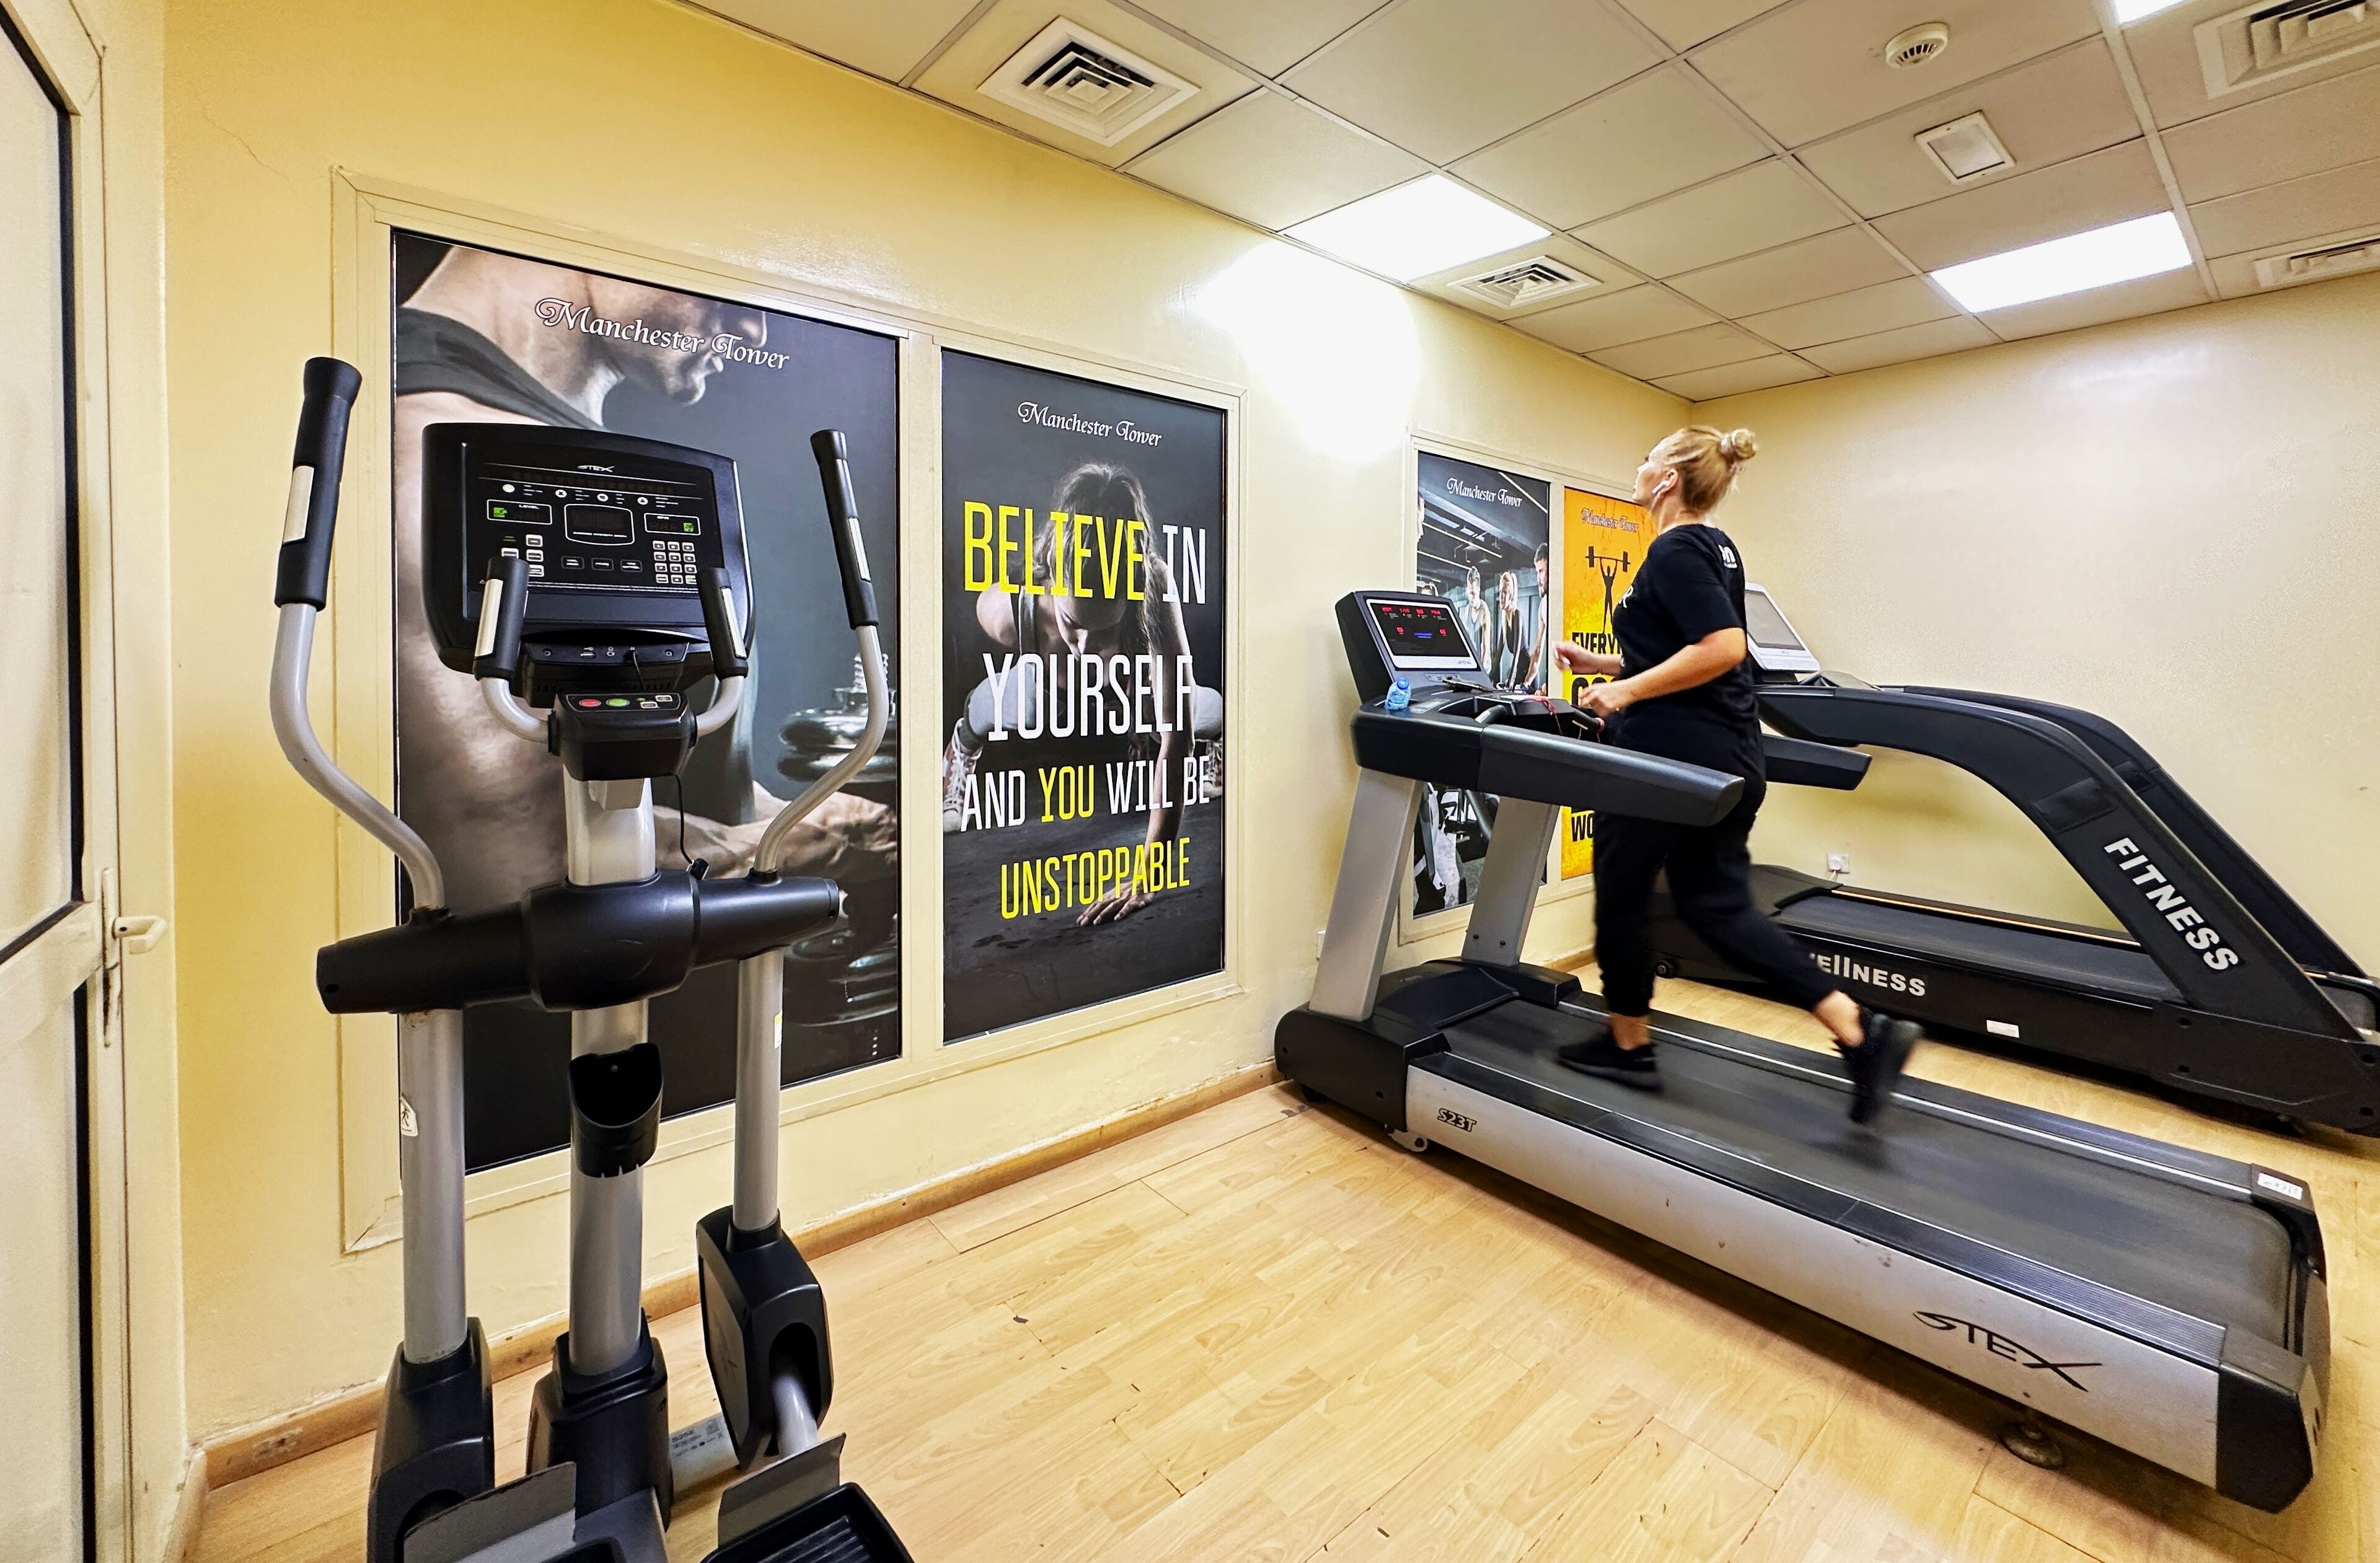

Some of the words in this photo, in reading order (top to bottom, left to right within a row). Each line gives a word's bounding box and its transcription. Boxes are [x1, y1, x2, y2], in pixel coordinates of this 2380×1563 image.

[535, 297, 705, 353] Manchester
[711, 333, 790, 369] Tower
[1018, 401, 1113, 437] Manchester
[1116, 420, 1162, 446] Tower
[1447, 477, 1497, 502] Manchester
[1497, 488, 1523, 507] Tower
[1580, 508, 1618, 529] Manchester
[1620, 516, 1639, 533] Tower
[964, 501, 1145, 601] BELIEVE
[1162, 524, 1206, 604] IN
[1572, 632, 1621, 654] EVERY
[982, 652, 1193, 741] YOURSELF
[961, 769, 1026, 832] AND
[1038, 765, 1095, 822] YOU
[1106, 759, 1173, 814] WILL
[1183, 755, 1210, 806] BE
[1000, 837, 1191, 920] UNSTOPPABLE
[2104, 837, 2239, 970] FITNESS
[1437, 1108, 1477, 1132] S23T
[1913, 1311, 2102, 1393] STEX
